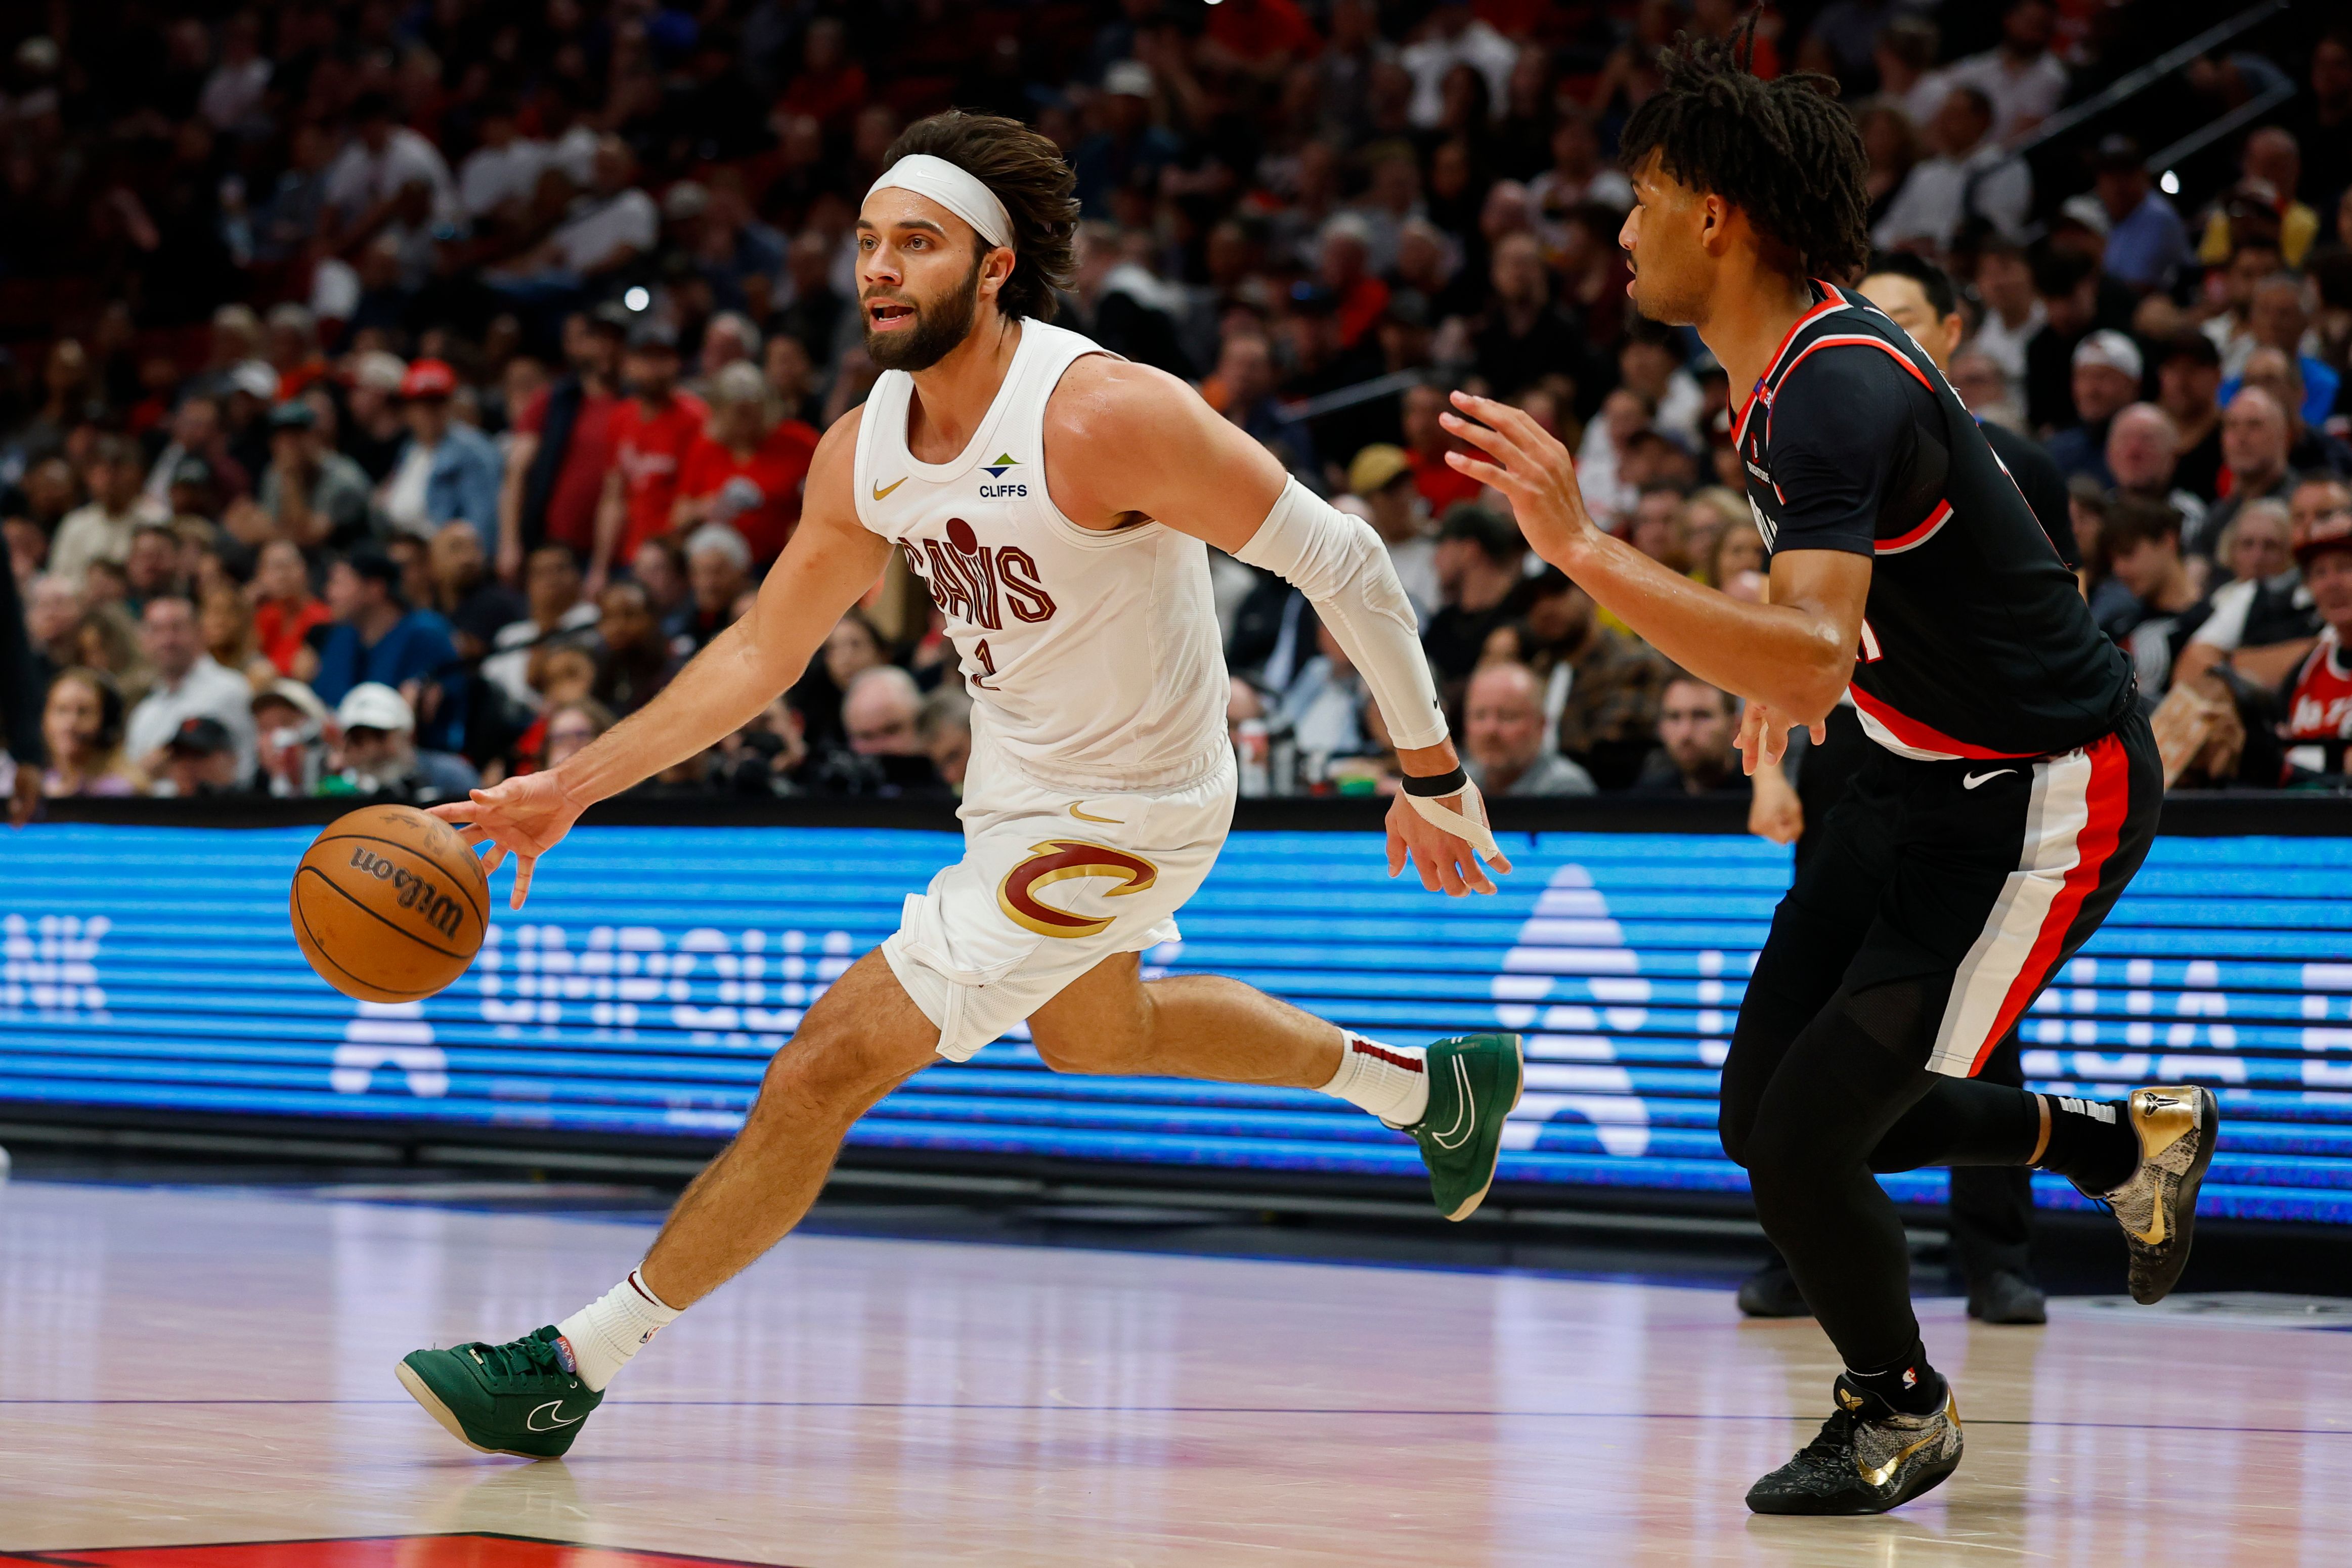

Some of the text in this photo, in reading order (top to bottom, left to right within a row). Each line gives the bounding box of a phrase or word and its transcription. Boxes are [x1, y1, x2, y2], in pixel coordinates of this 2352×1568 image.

[979, 484, 1027, 498] CLIFFS
[898, 518, 1057, 630] CAVS
[349, 846, 464, 942] Wilson
[3, 912, 112, 1026] NK
[559, 1340, 575, 1368] BOOK
